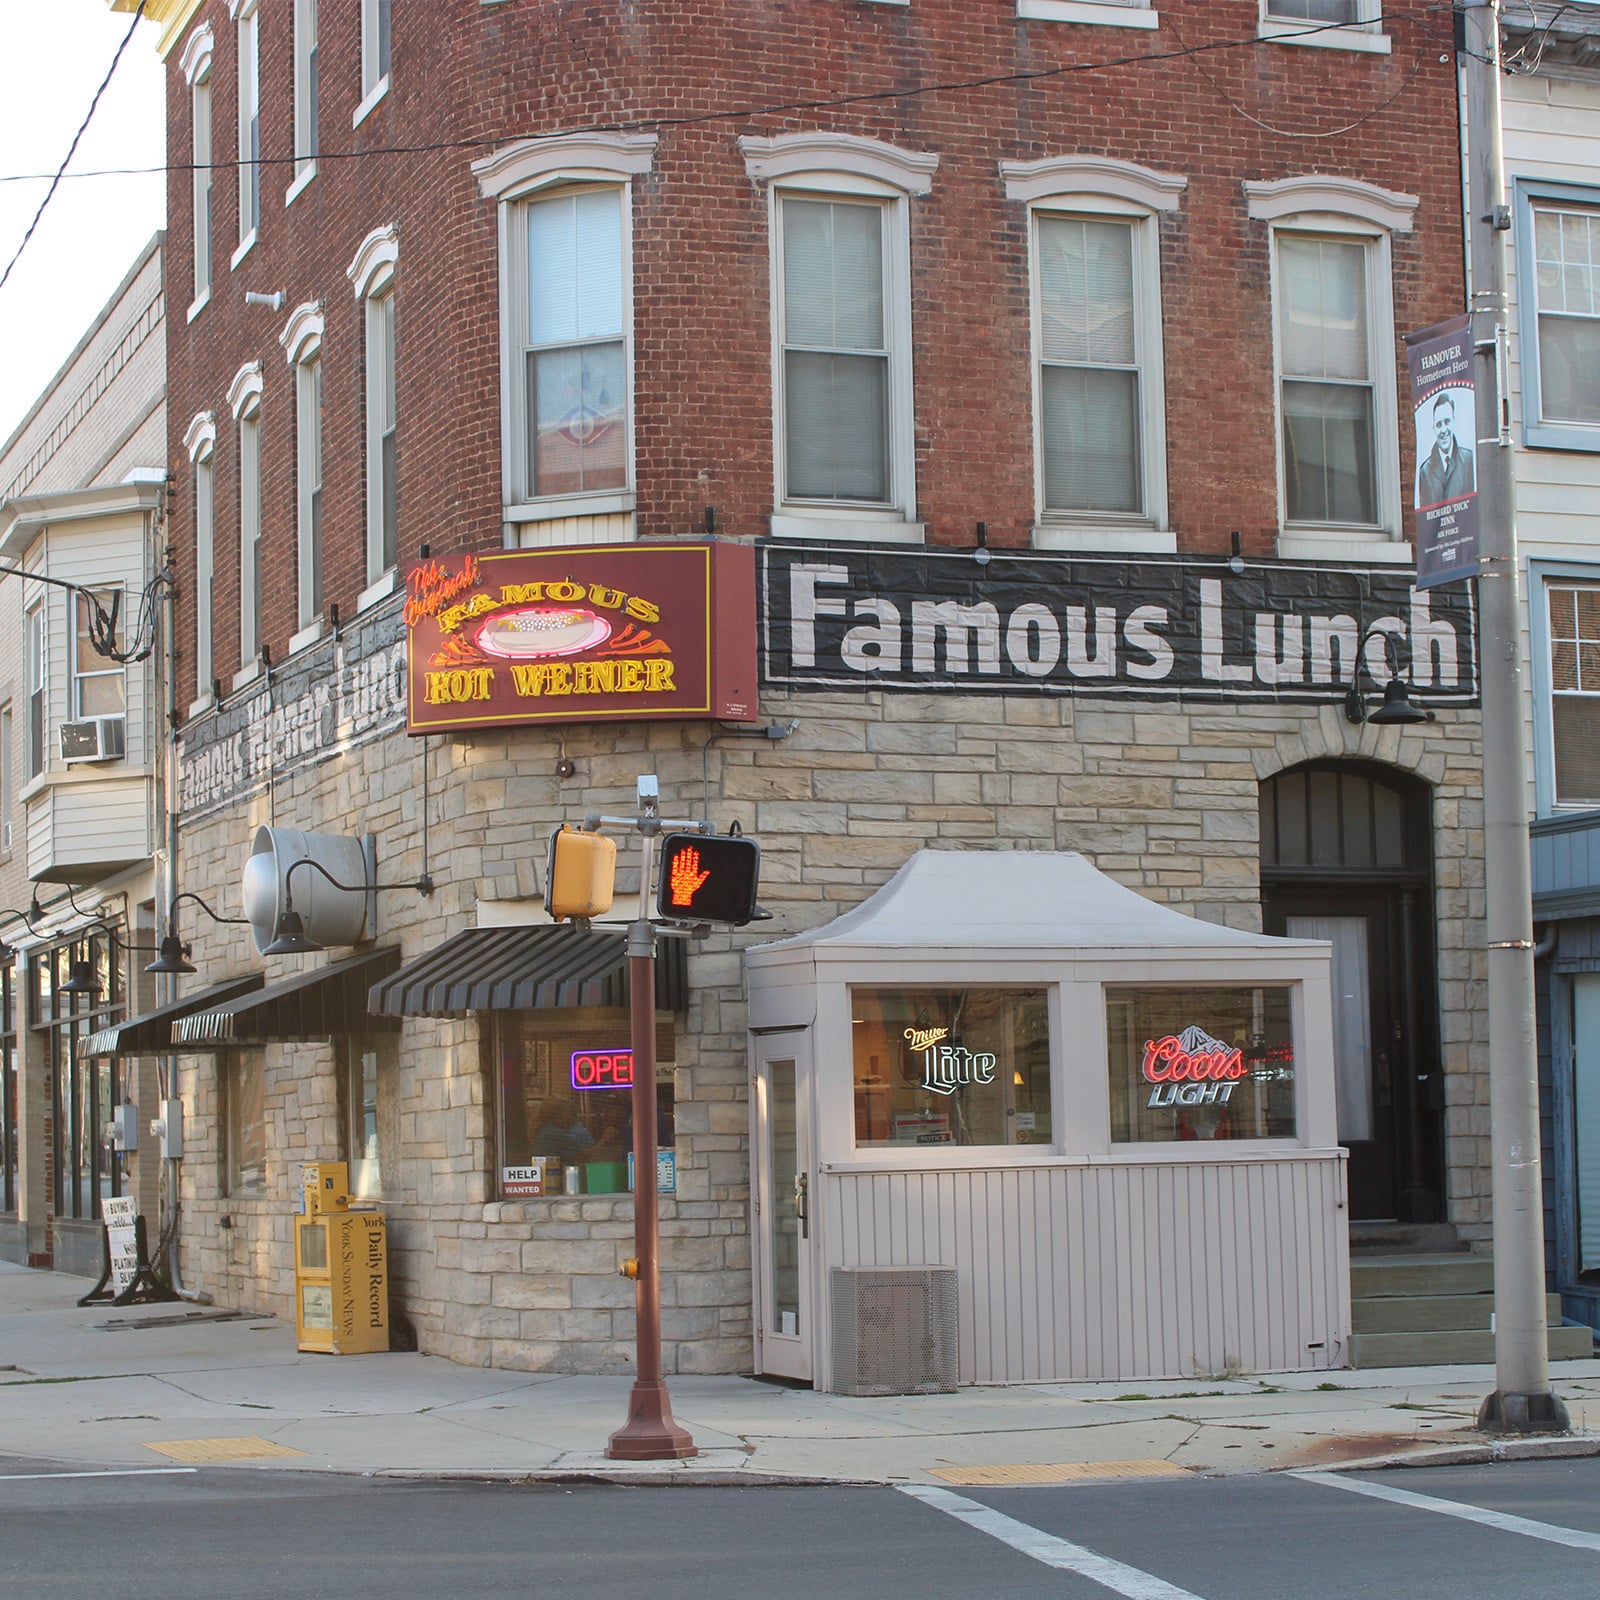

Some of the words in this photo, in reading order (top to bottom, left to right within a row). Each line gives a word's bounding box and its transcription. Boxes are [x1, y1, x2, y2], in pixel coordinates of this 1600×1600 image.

[1421, 345, 1461, 369] HANOVER
[1416, 366, 1451, 385] Hometown
[1452, 360, 1469, 374] Hero
[1426, 505, 1451, 520] RICHARD
[1440, 514, 1455, 527] ZINN
[1446, 526, 1459, 536] FORCE
[406, 559, 446, 593] The
[435, 580, 660, 635] FAMOUS
[789, 562, 1170, 680] Famous
[1199, 578, 1459, 688] Lunch
[336, 640, 407, 738] Lunc
[423, 667, 496, 705] HOT
[509, 658, 677, 697] WEINER
[903, 1027, 949, 1046] Miller
[575, 1056, 633, 1084] OPE
[921, 1045, 996, 1095] Lite
[1142, 1035, 1248, 1083] Coors
[1146, 1081, 1240, 1109] LIGHT
[508, 1169, 538, 1180] HELP
[504, 1185, 540, 1195] WANTED
[341, 1219, 353, 1249] YORK
[363, 1216, 385, 1228] York
[113, 1257, 136, 1271] PLATINU
[365, 1231, 383, 1271] Daily
[342, 1251, 354, 1297] SUNDAY
[369, 1274, 383, 1329] Record
[343, 1299, 355, 1336] NEWS
